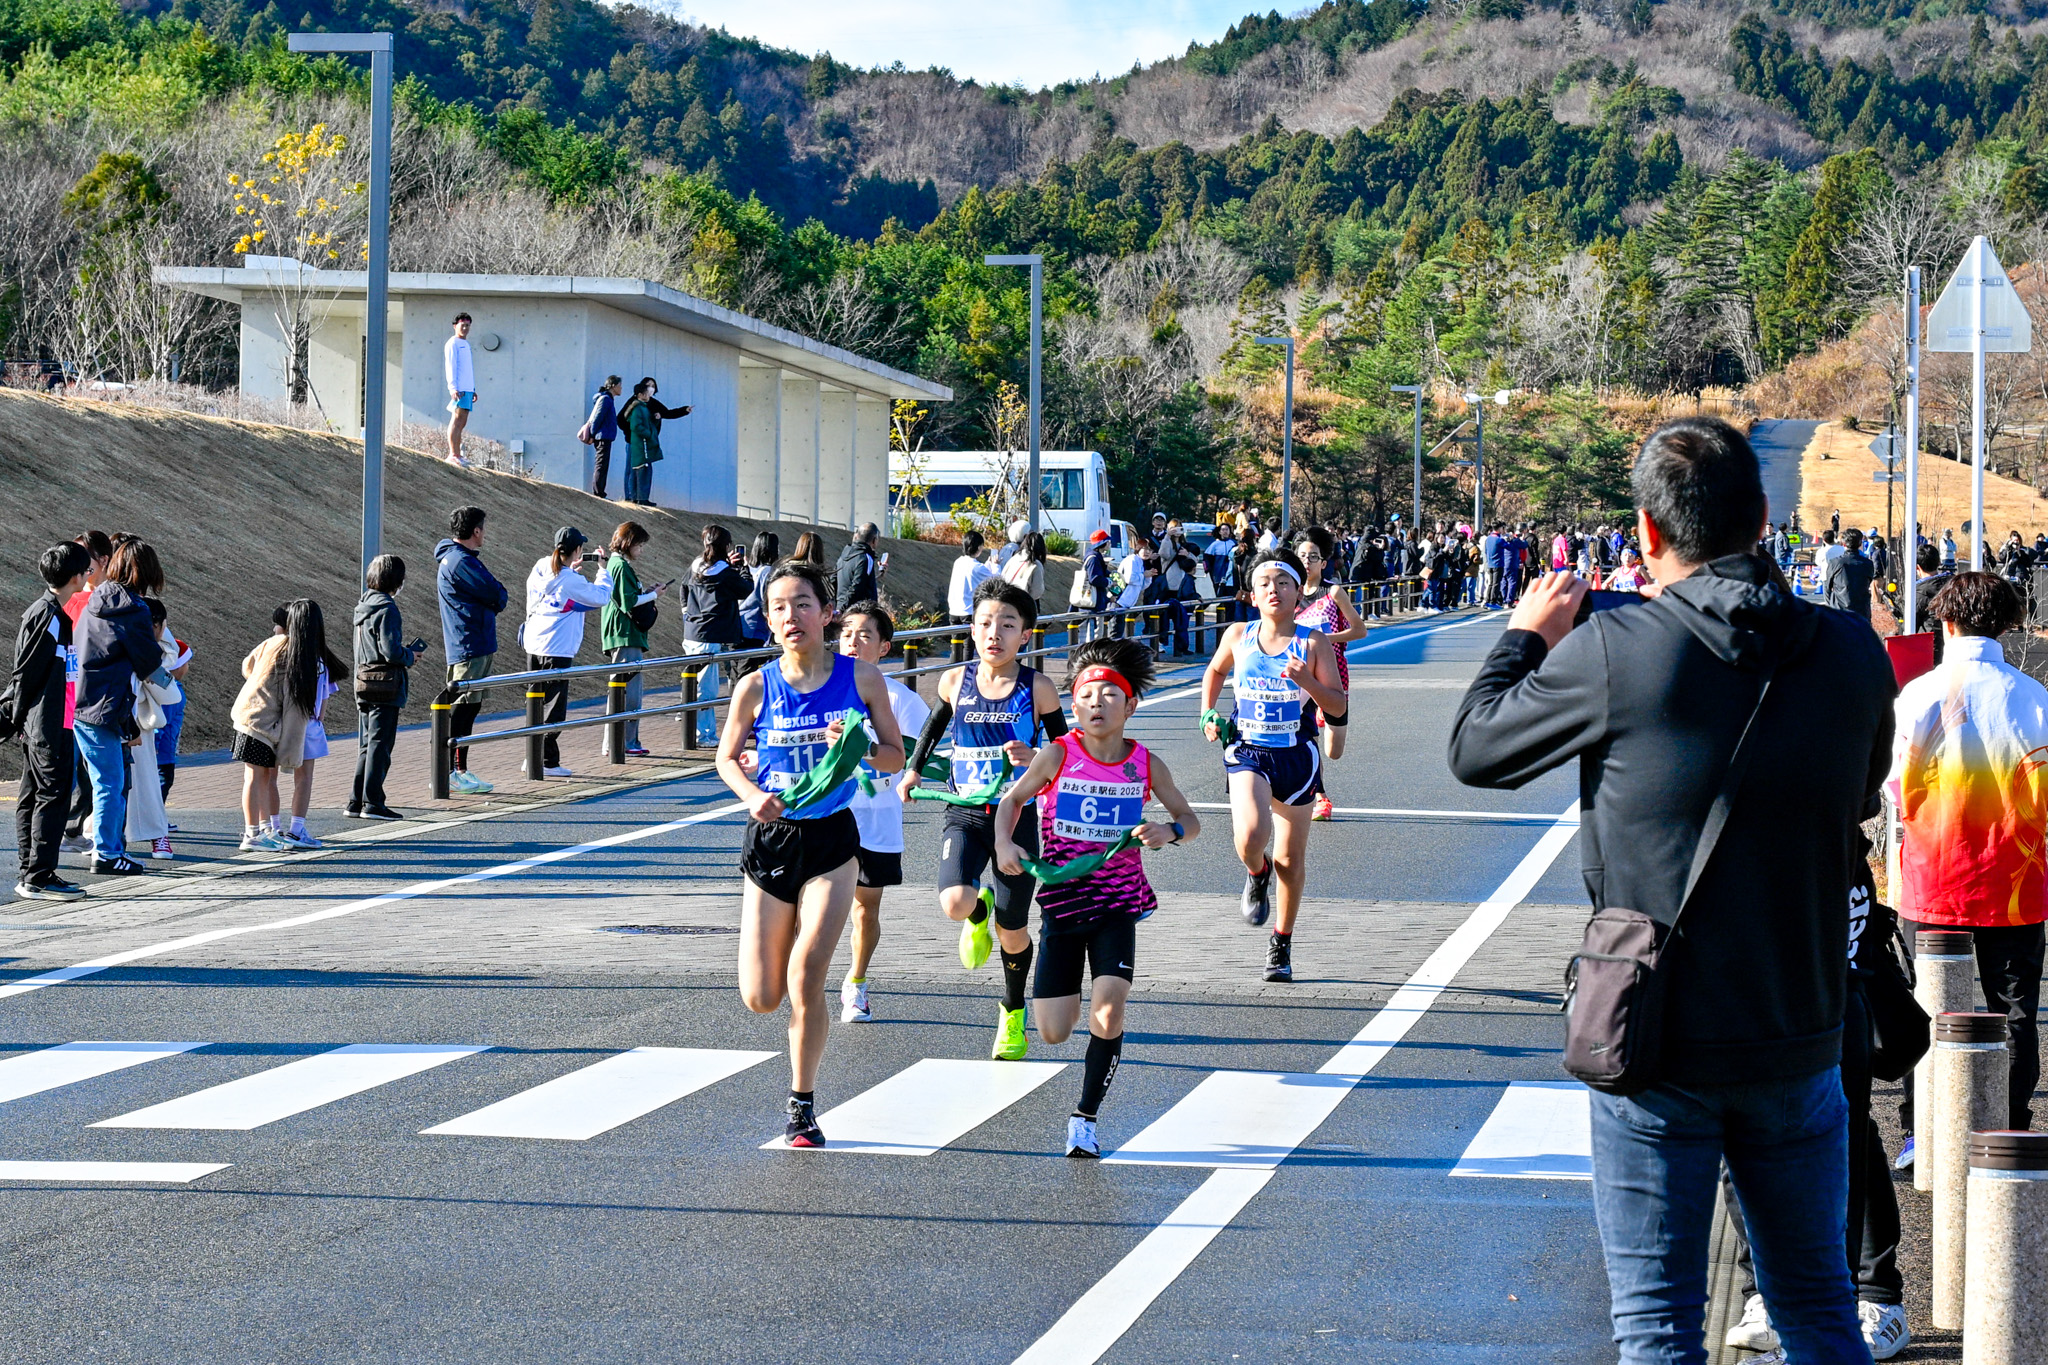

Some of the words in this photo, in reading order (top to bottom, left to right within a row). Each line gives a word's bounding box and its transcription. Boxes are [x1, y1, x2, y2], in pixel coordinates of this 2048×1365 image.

[1247, 676, 1288, 690] TOWA
[964, 712, 1021, 723] earnest
[1254, 701, 1283, 721] 8-1
[773, 713, 818, 730] Nexus
[1062, 782, 1117, 796] おおくま駅伝
[1120, 786, 1141, 796] 2025
[1080, 796, 1120, 825] 6-1
